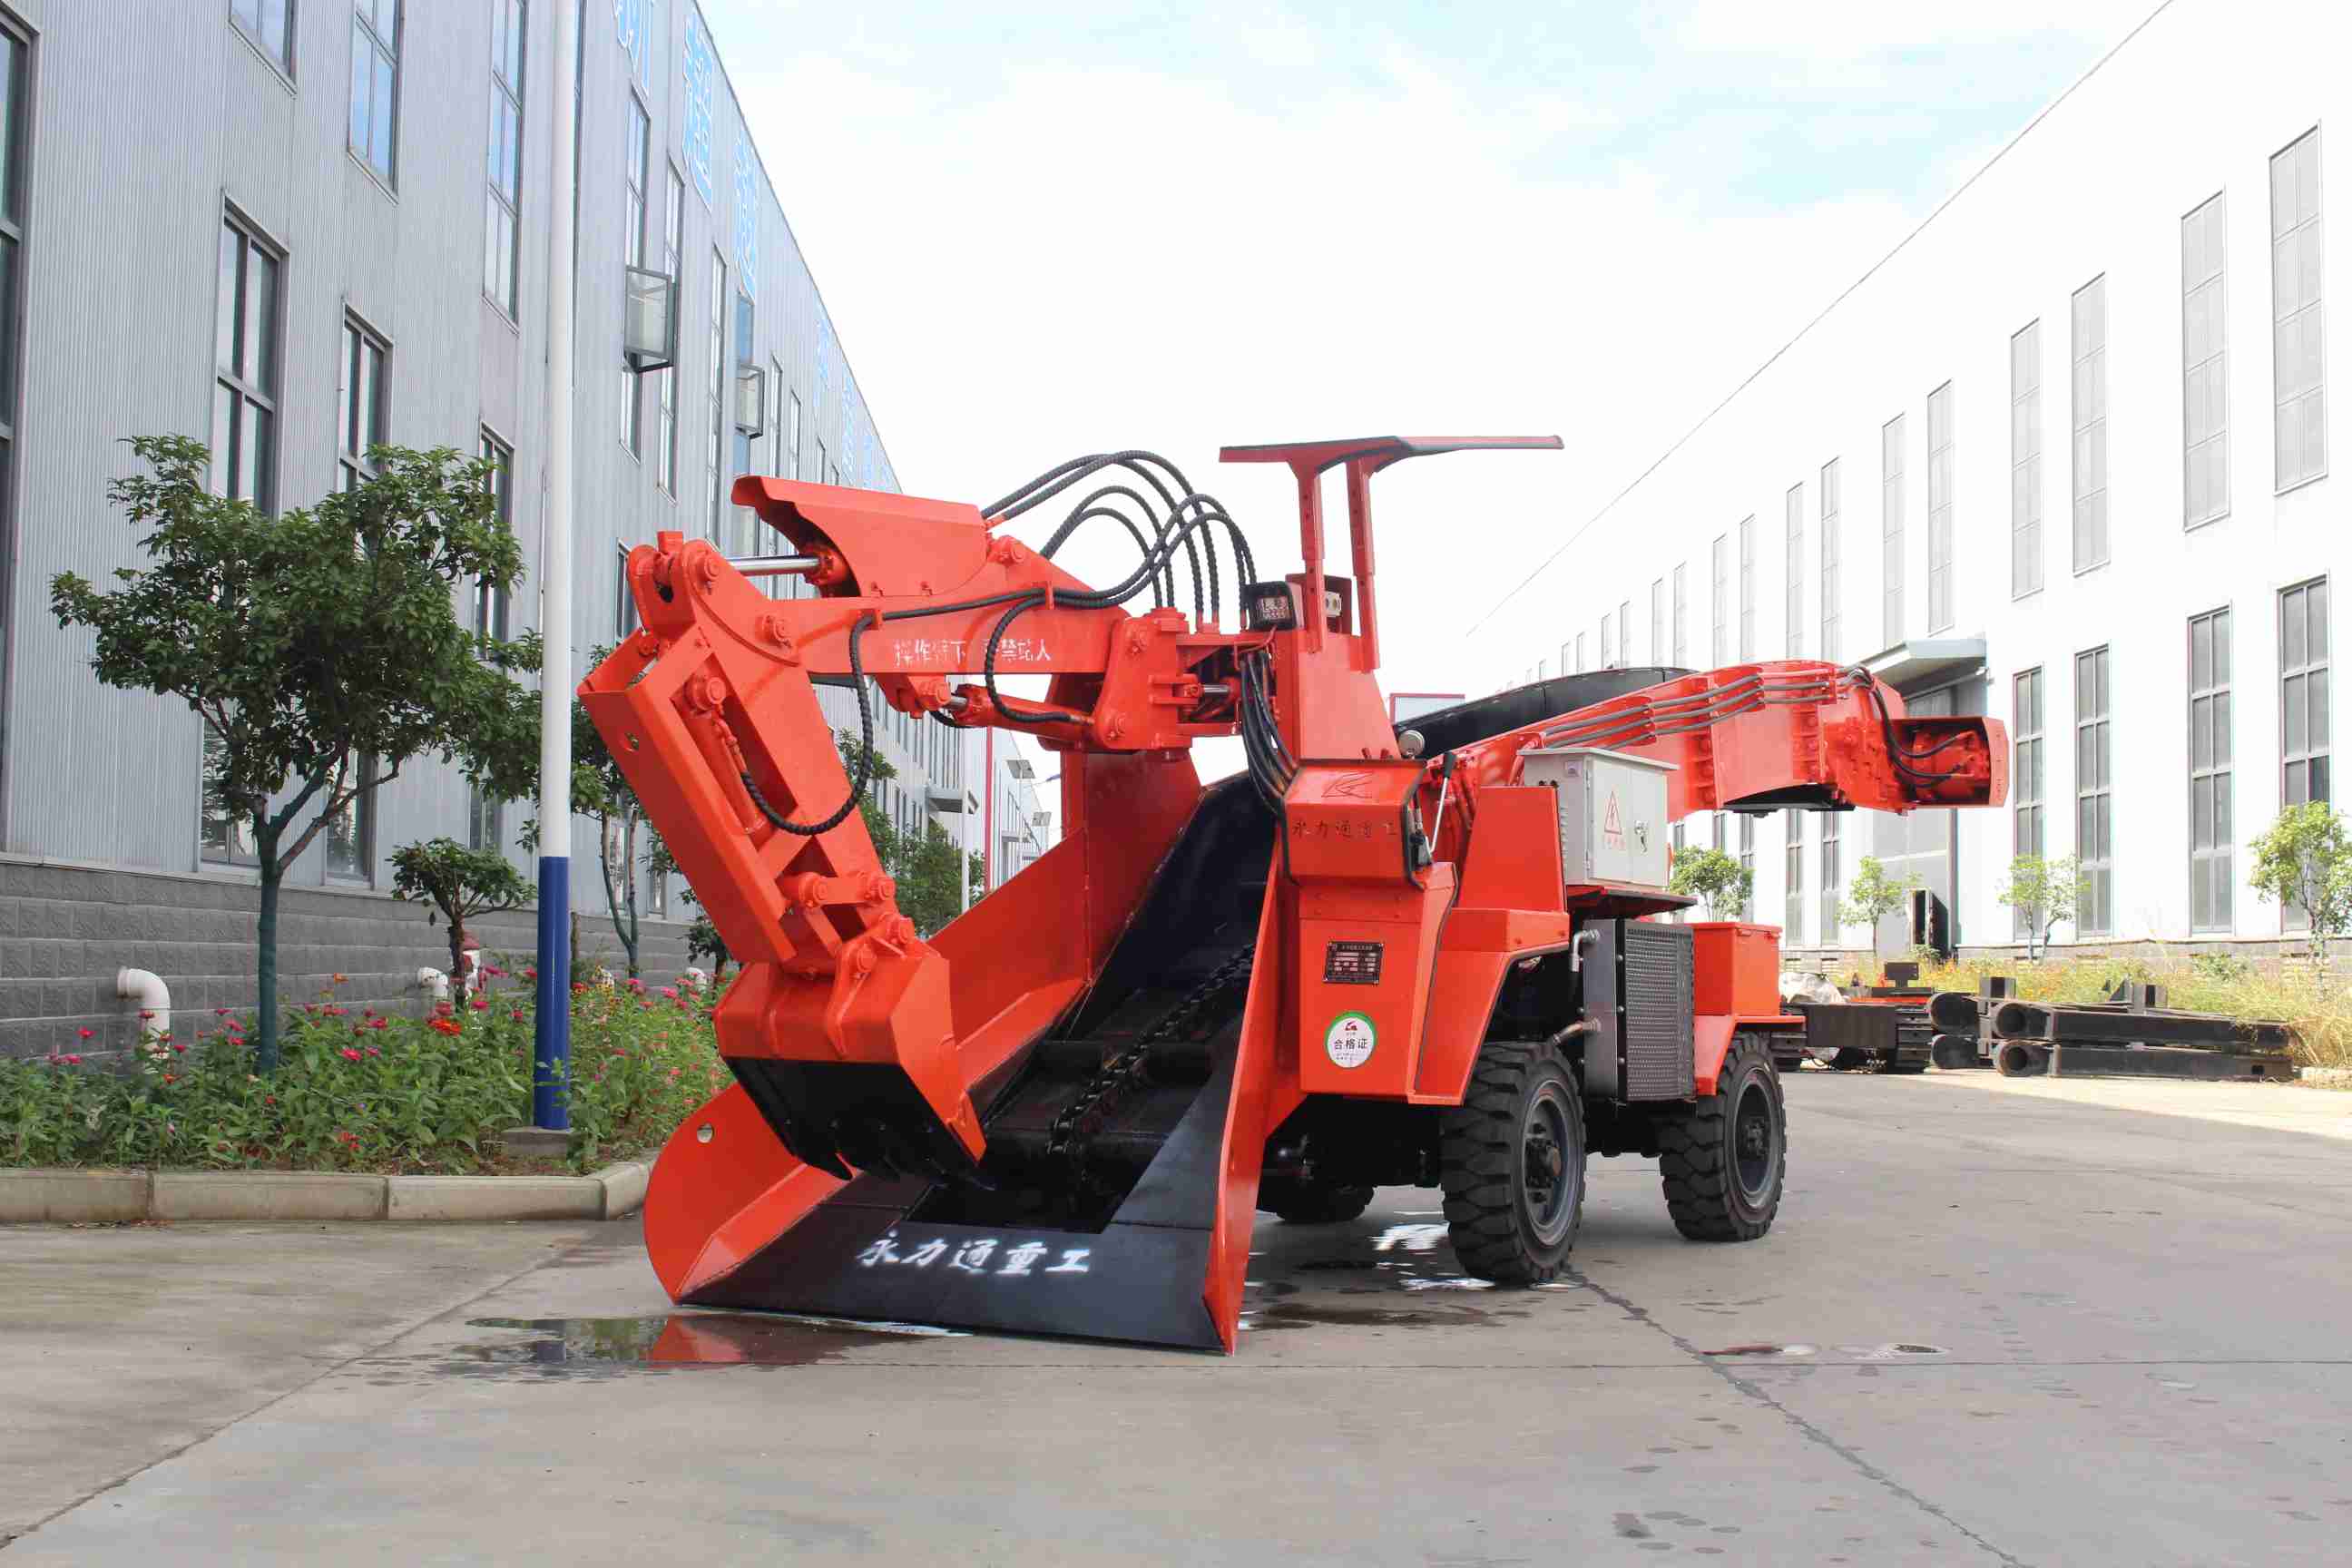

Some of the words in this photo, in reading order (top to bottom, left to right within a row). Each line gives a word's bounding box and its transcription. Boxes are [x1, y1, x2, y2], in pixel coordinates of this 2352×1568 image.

[1335, 1038, 1367, 1050] 合格证
[857, 1230, 1091, 1275] 永力通重工
